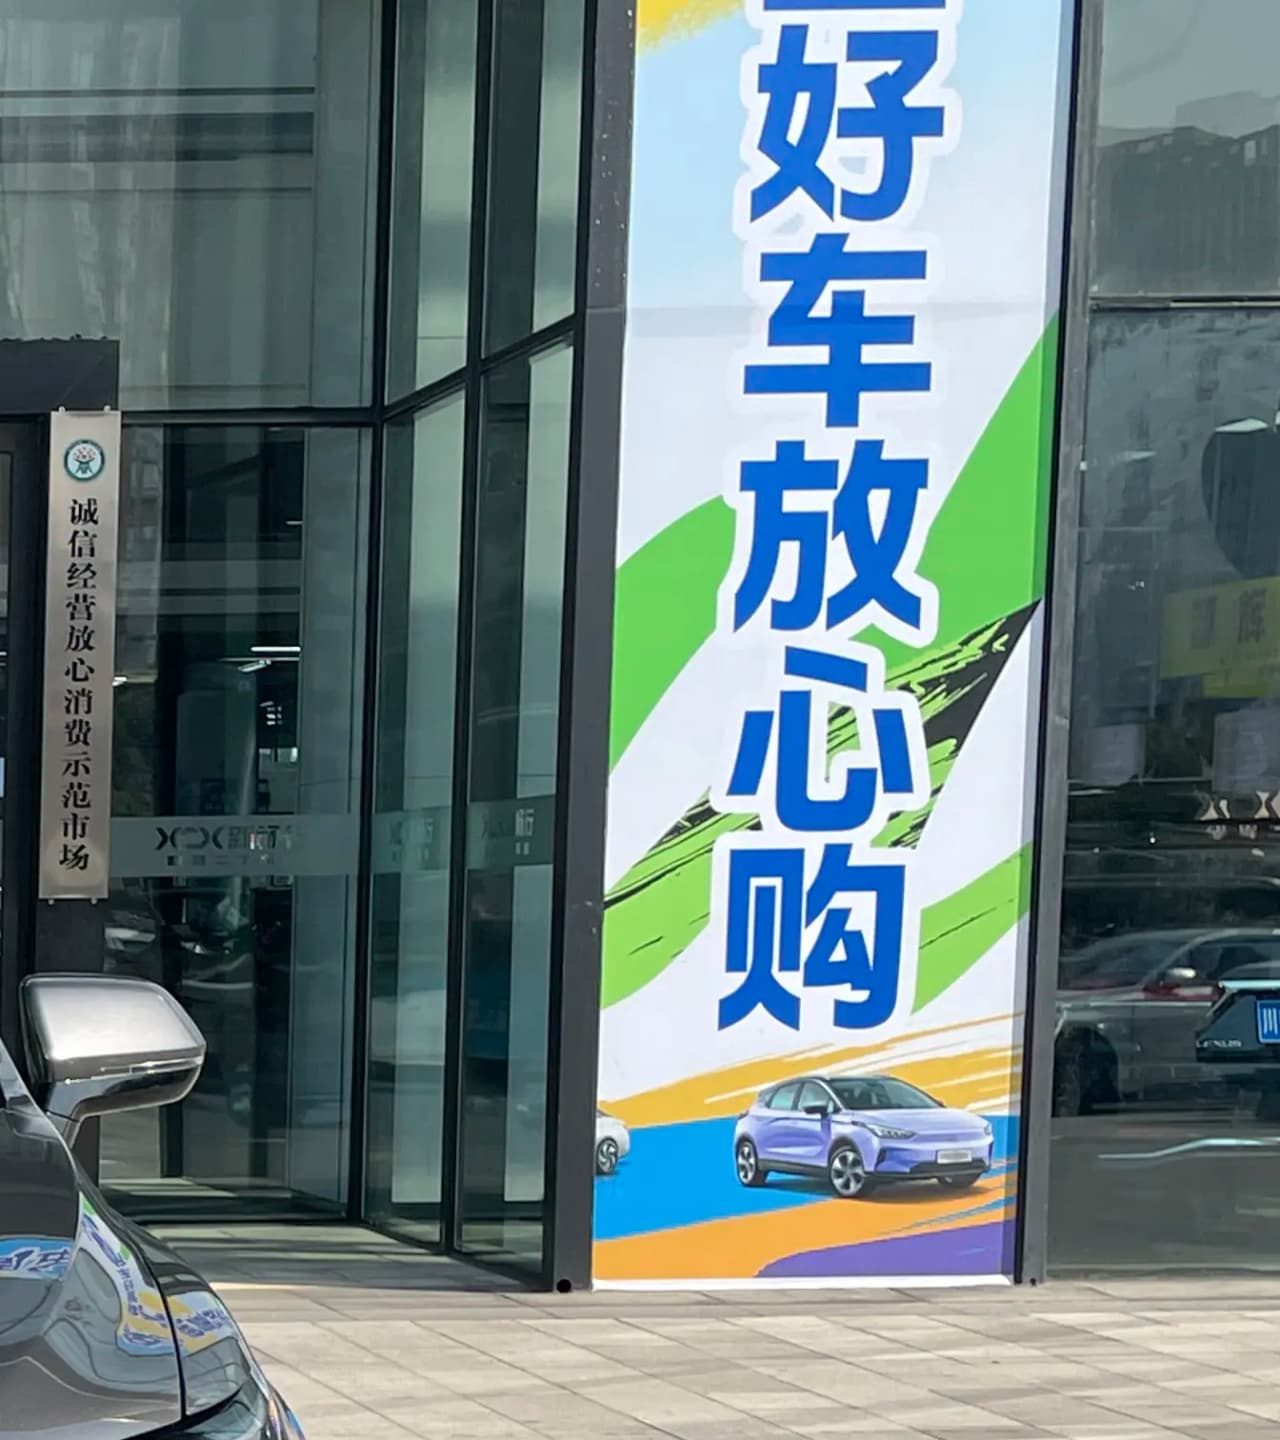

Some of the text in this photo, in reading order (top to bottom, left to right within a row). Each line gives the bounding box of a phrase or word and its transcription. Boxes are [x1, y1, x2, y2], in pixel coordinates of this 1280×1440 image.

[58, 498, 100, 871] 诚信经营放心消费示范市场
[717, 0, 945, 1032] 好车放心购
